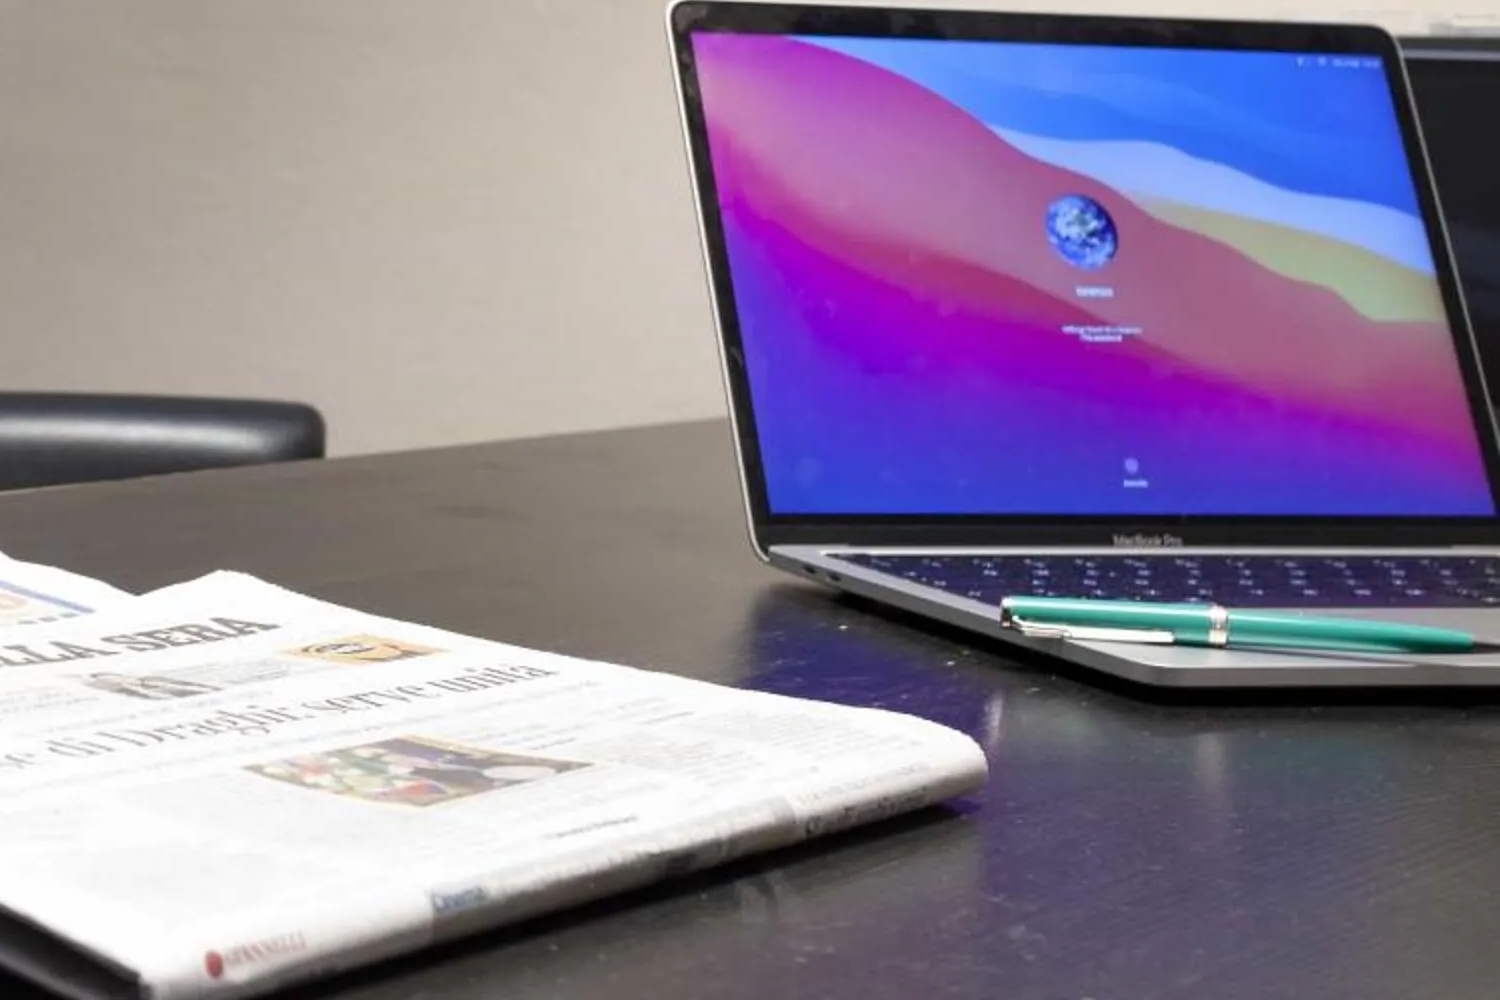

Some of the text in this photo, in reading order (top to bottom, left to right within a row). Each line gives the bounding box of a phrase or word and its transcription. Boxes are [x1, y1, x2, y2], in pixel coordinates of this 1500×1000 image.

[1113, 534, 1182, 548] MacBook Pro
[101, 616, 281, 653] SERA
[46, 737, 116, 758] di
[300, 684, 440, 717] serve
